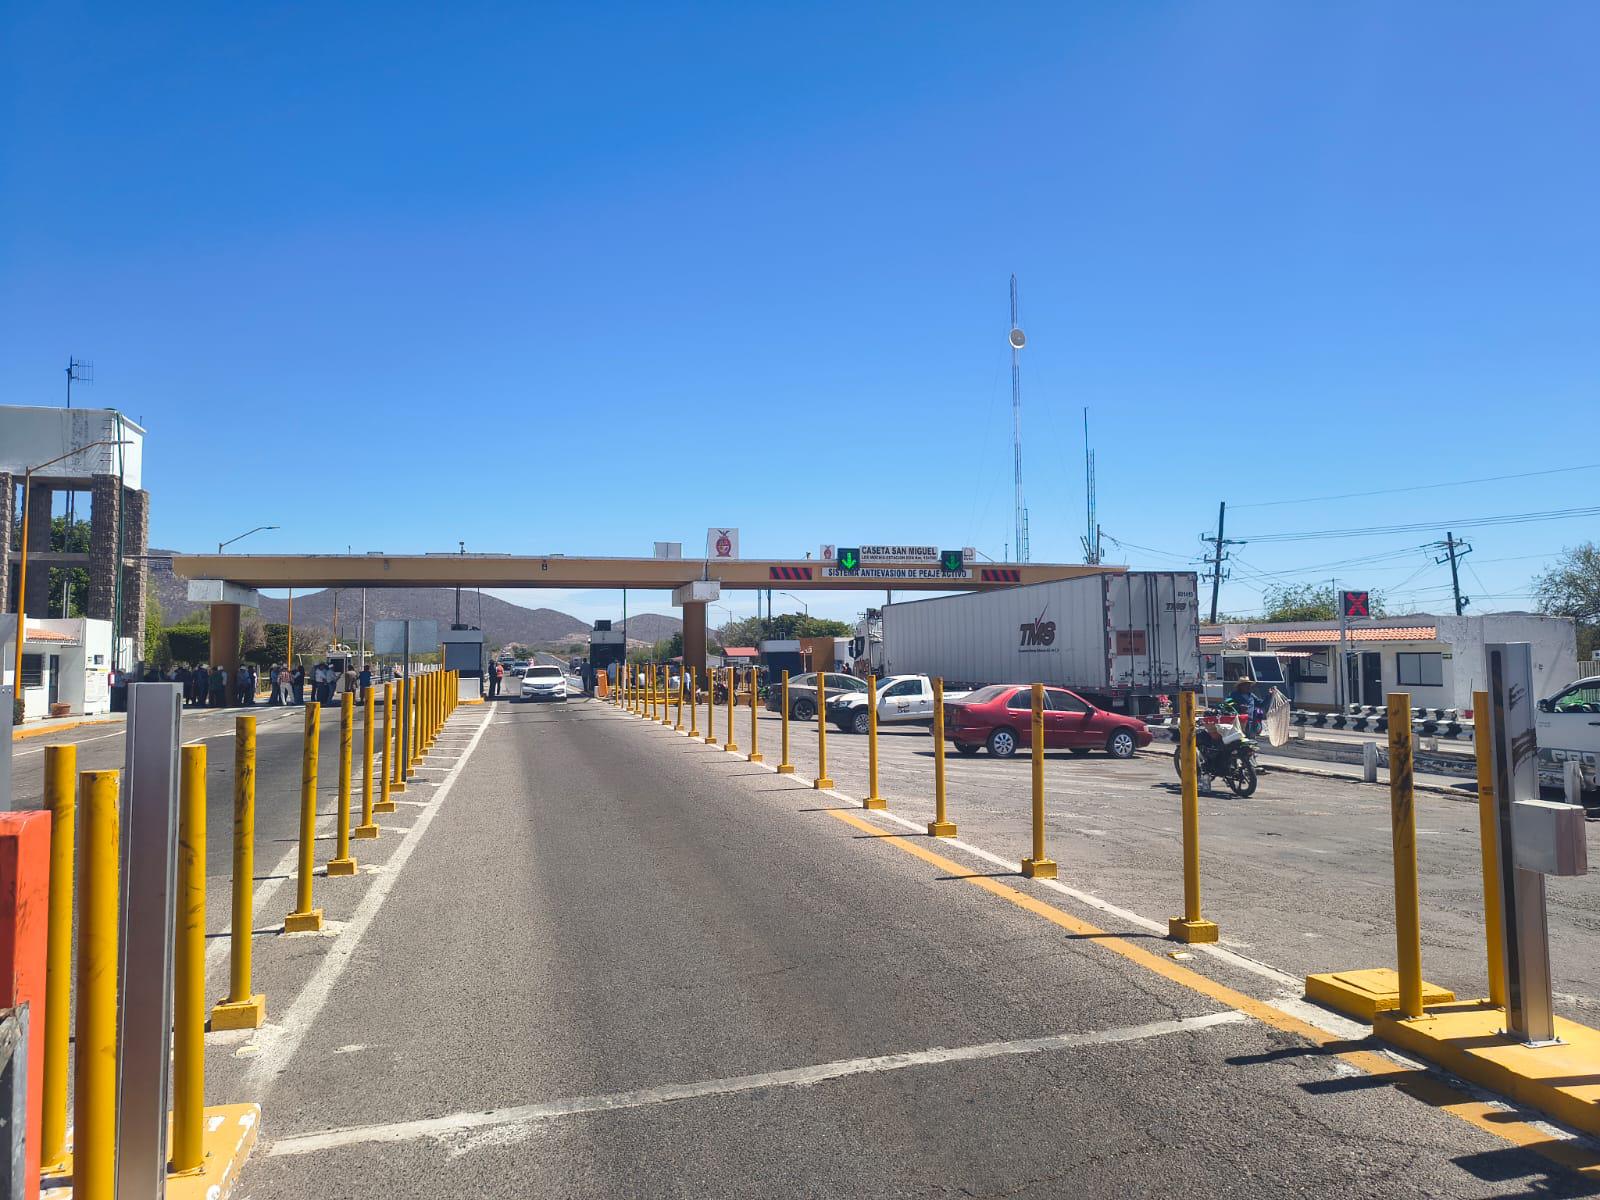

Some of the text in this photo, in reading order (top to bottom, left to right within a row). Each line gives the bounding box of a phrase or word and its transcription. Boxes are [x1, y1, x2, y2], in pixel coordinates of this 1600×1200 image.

[862, 547, 937, 556] CASETA SAN MIGUEL
[828, 568, 967, 578] SISTEMA ANTIEVASION DE PEAJE ACTIVO
[1020, 621, 1056, 646] TMS
